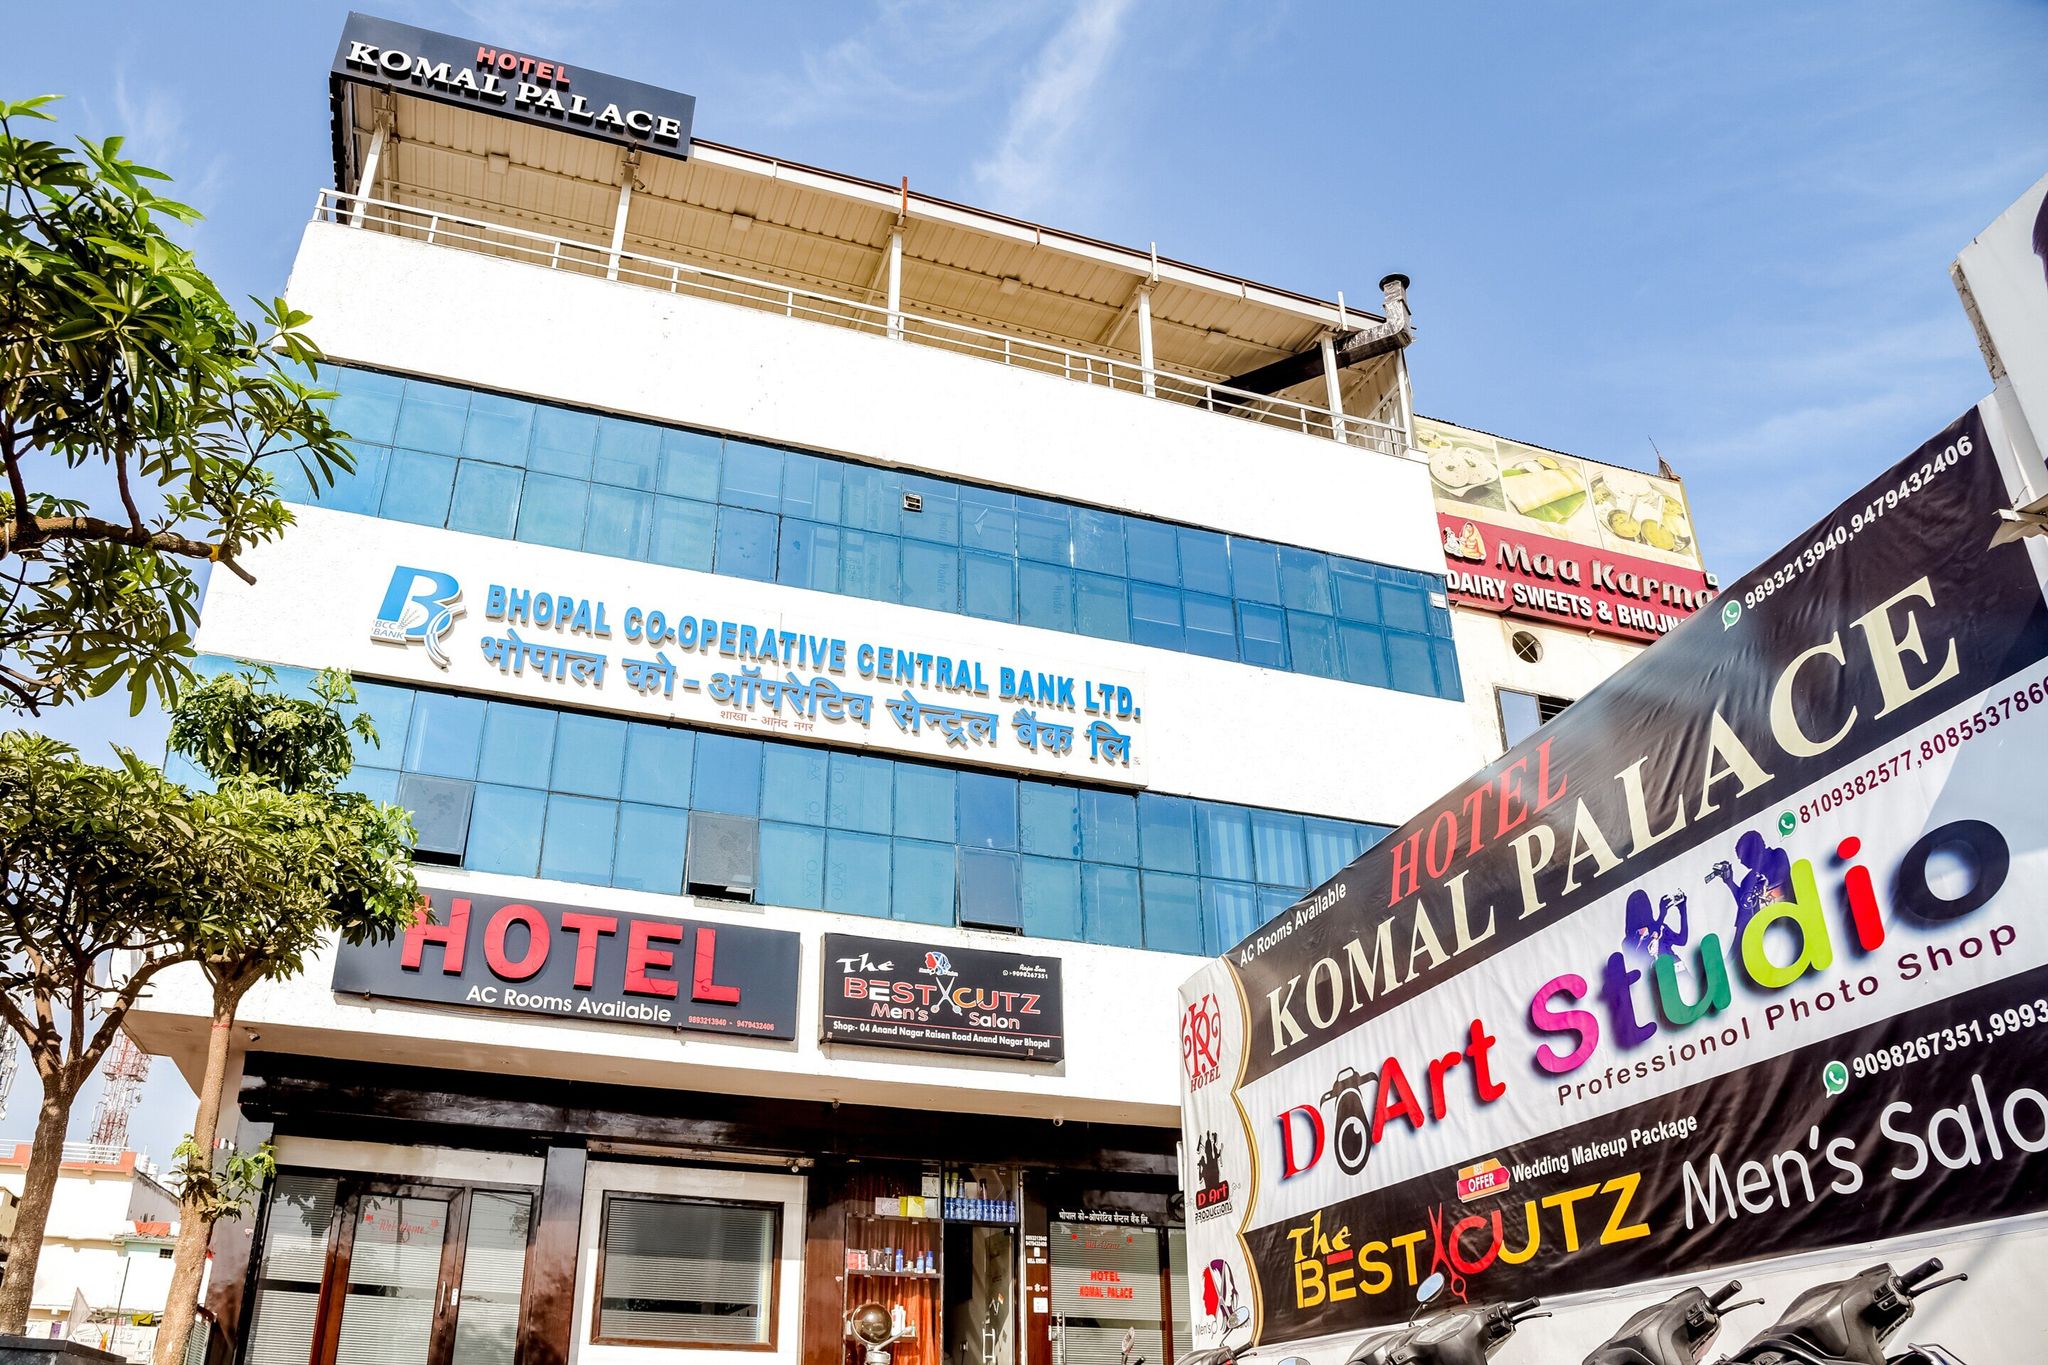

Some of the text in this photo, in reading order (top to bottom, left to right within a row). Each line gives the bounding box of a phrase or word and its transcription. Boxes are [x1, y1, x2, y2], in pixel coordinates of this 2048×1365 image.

[346, 41, 681, 140] KOMAL PALACE
[477, 46, 570, 83] HOTEL
[1446, 569, 1685, 633] DAIRY SWEETS & BHOJN
[1497, 540, 1713, 610] Maa Karma
[373, 628, 404, 639] BANK
[375, 620, 396, 630] BCC
[485, 584, 1141, 720] BHOPAL CO-OPERATIVE CENTRAL BANK LTD.
[480, 628, 607, 688] भोपाल
[885, 689, 999, 746] सेन्ट्रल
[1011, 707, 1074, 753] बैंक
[1085, 719, 1132, 763] लि
[720, 710, 747, 722] शाखा
[761, 715, 788, 728] आनंद
[794, 721, 814, 732] नगर
[1266, 575, 1960, 1056] KOMAL PALACE
[1387, 736, 1568, 909] HOTEL
[401, 893, 742, 1004] HOTEL
[1239, 882, 1347, 968] AC Rooms Available
[836, 952, 895, 974] The
[1371, 1018, 1507, 1146] Art
[1530, 819, 2011, 1074] Studio
[1764, 975, 1880, 1032] Photo
[1897, 923, 2018, 981] Shop
[466, 985, 672, 1023] AC Rooms Available
[843, 976, 1041, 1015] BEST CUTZ
[870, 1002, 1020, 1030] Men's Salon
[860, 1024, 870, 1033] 04
[872, 1024, 898, 1036] Anand
[899, 1027, 925, 1040] Nagar
[925, 1029, 950, 1040] Raisen
[952, 1032, 972, 1042] Road
[973, 1034, 998, 1045] Anand
[999, 1035, 1023, 1047] Nagar
[1024, 1037, 1051, 1050] Bhopal
[1190, 1065, 1221, 1094] HOTEL
[1511, 1115, 1698, 1183] Wedding Makeup Package
[1197, 1183, 1228, 1206] D Art
[1468, 1172, 1495, 1193] OFFER
[1287, 1211, 1352, 1264] The
[1294, 1229, 1427, 1310] BEST
[1448, 1172, 1651, 1276] CUTZ
[1682, 1125, 1864, 1231] Men's
[1090, 1270, 1121, 1283] HOTEL
